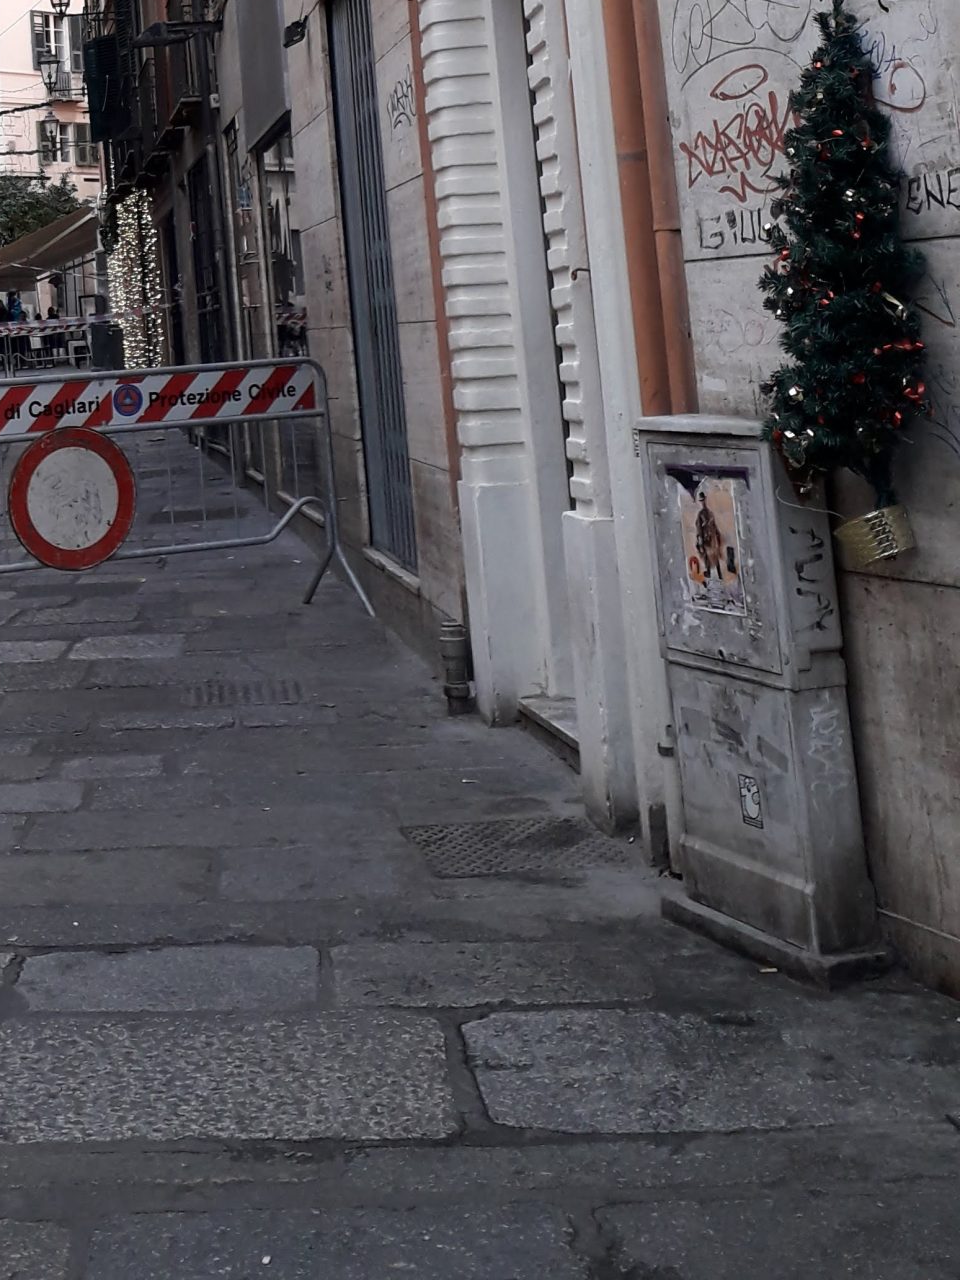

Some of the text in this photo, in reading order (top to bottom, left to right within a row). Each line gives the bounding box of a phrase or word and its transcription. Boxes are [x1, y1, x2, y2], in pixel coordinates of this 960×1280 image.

[148, 382, 297, 408] Protezione Civile
[3, 402, 22, 421] di
[28, 396, 101, 421] Cagliari
